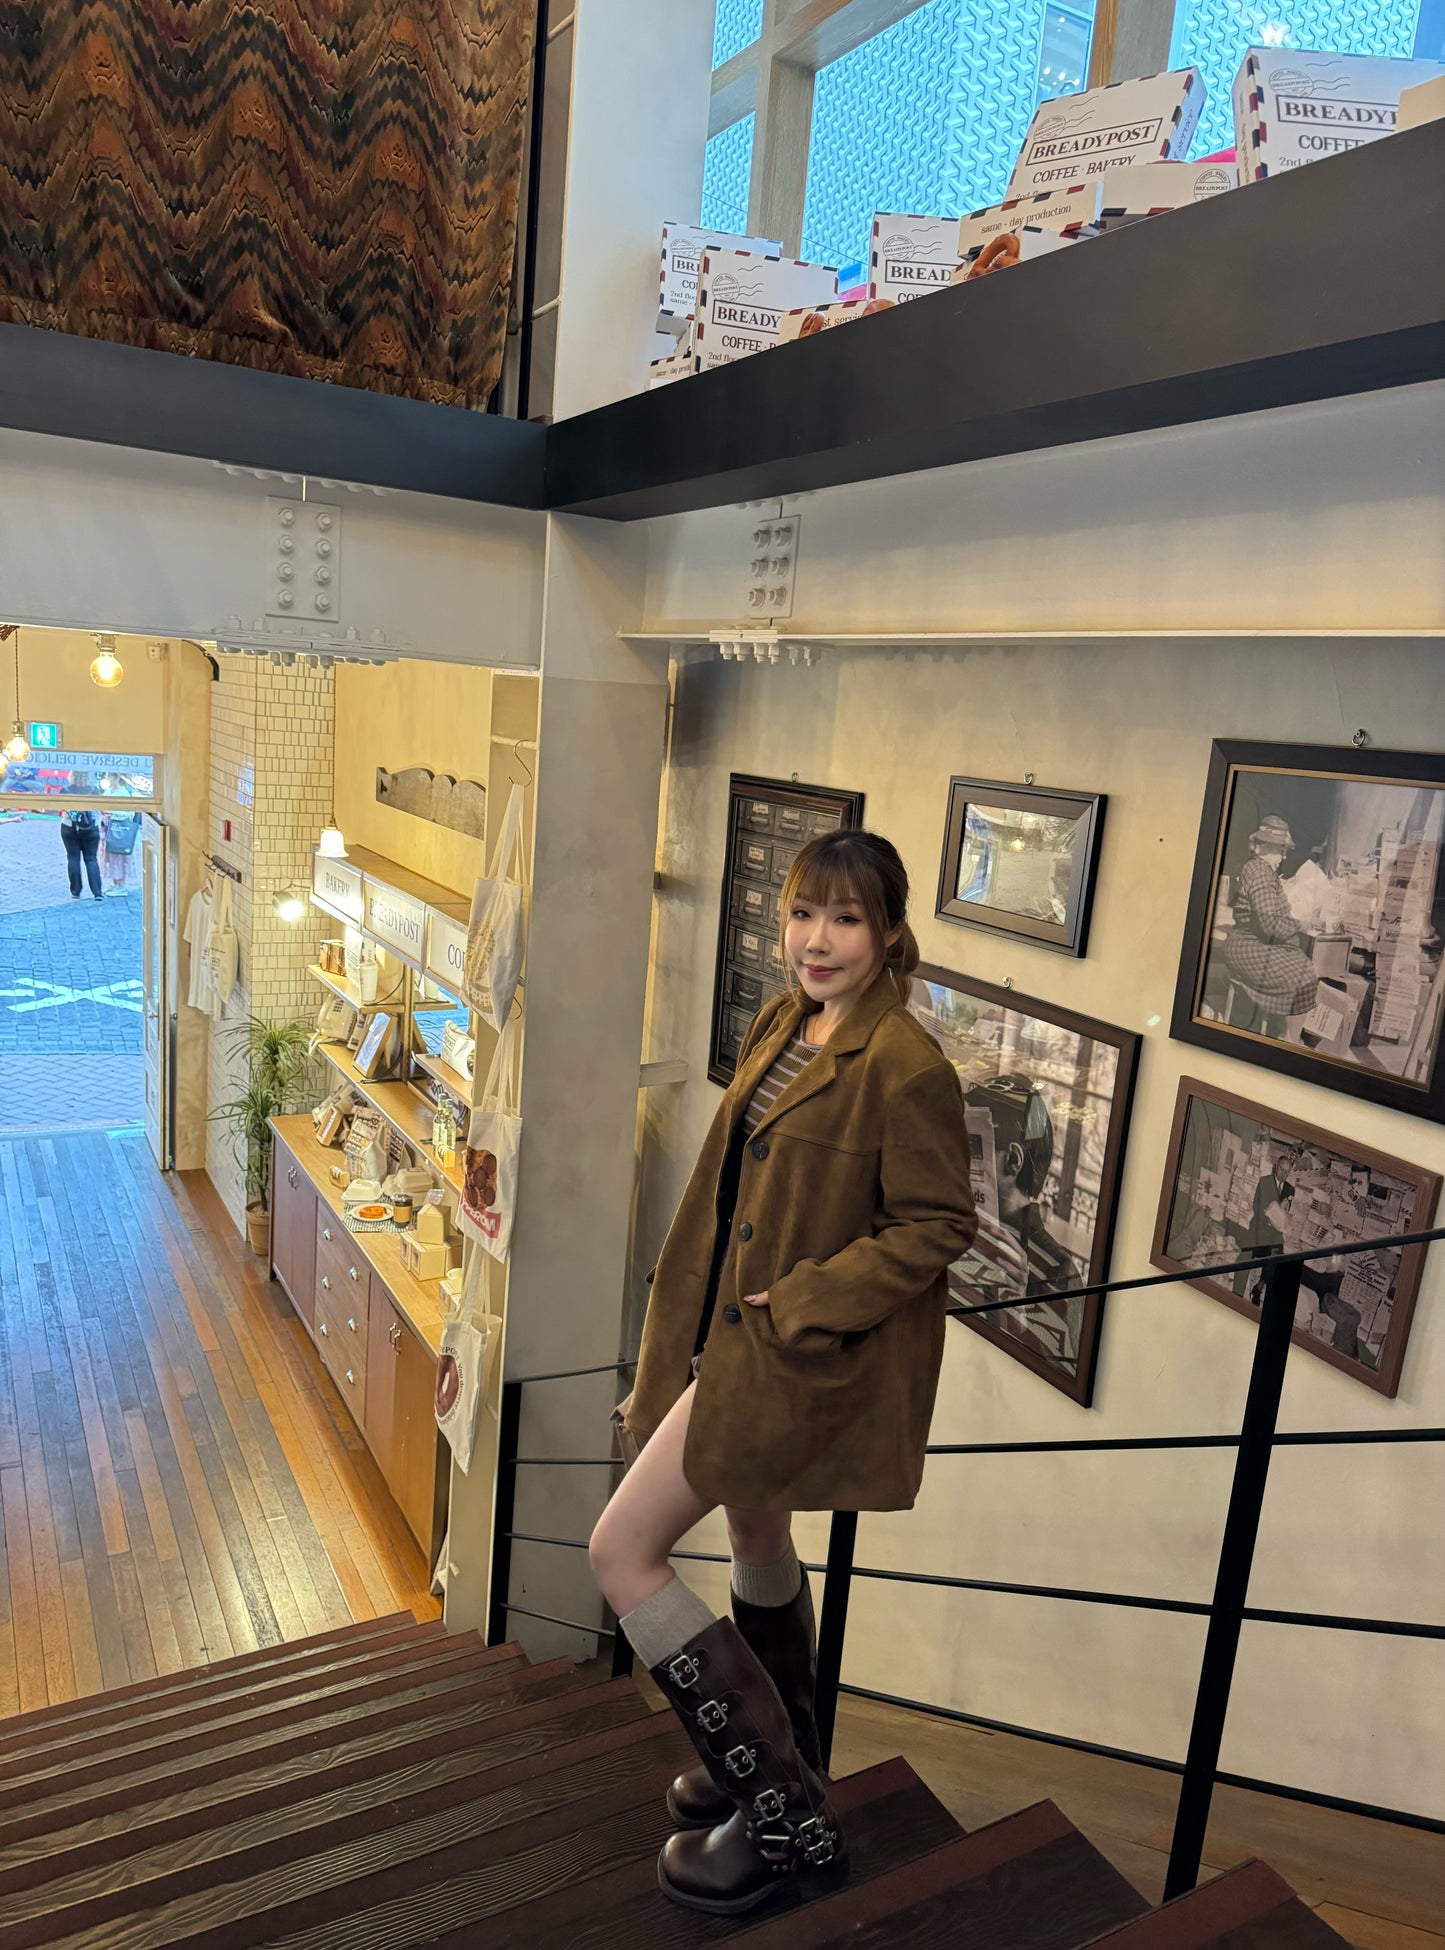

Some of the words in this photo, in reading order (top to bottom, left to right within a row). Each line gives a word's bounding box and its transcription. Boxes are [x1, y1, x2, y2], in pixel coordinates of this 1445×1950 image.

[1033, 124, 1155, 160] BREADYPOST
[1033, 164, 1081, 184] COFFEE
[981, 220, 1002, 235] same
[1009, 215, 1025, 230] day
[1025, 203, 1072, 227] production
[721, 334, 762, 353] COFFEE
[708, 351, 722, 361] 2nd
[325, 871, 351, 898] BAKERY
